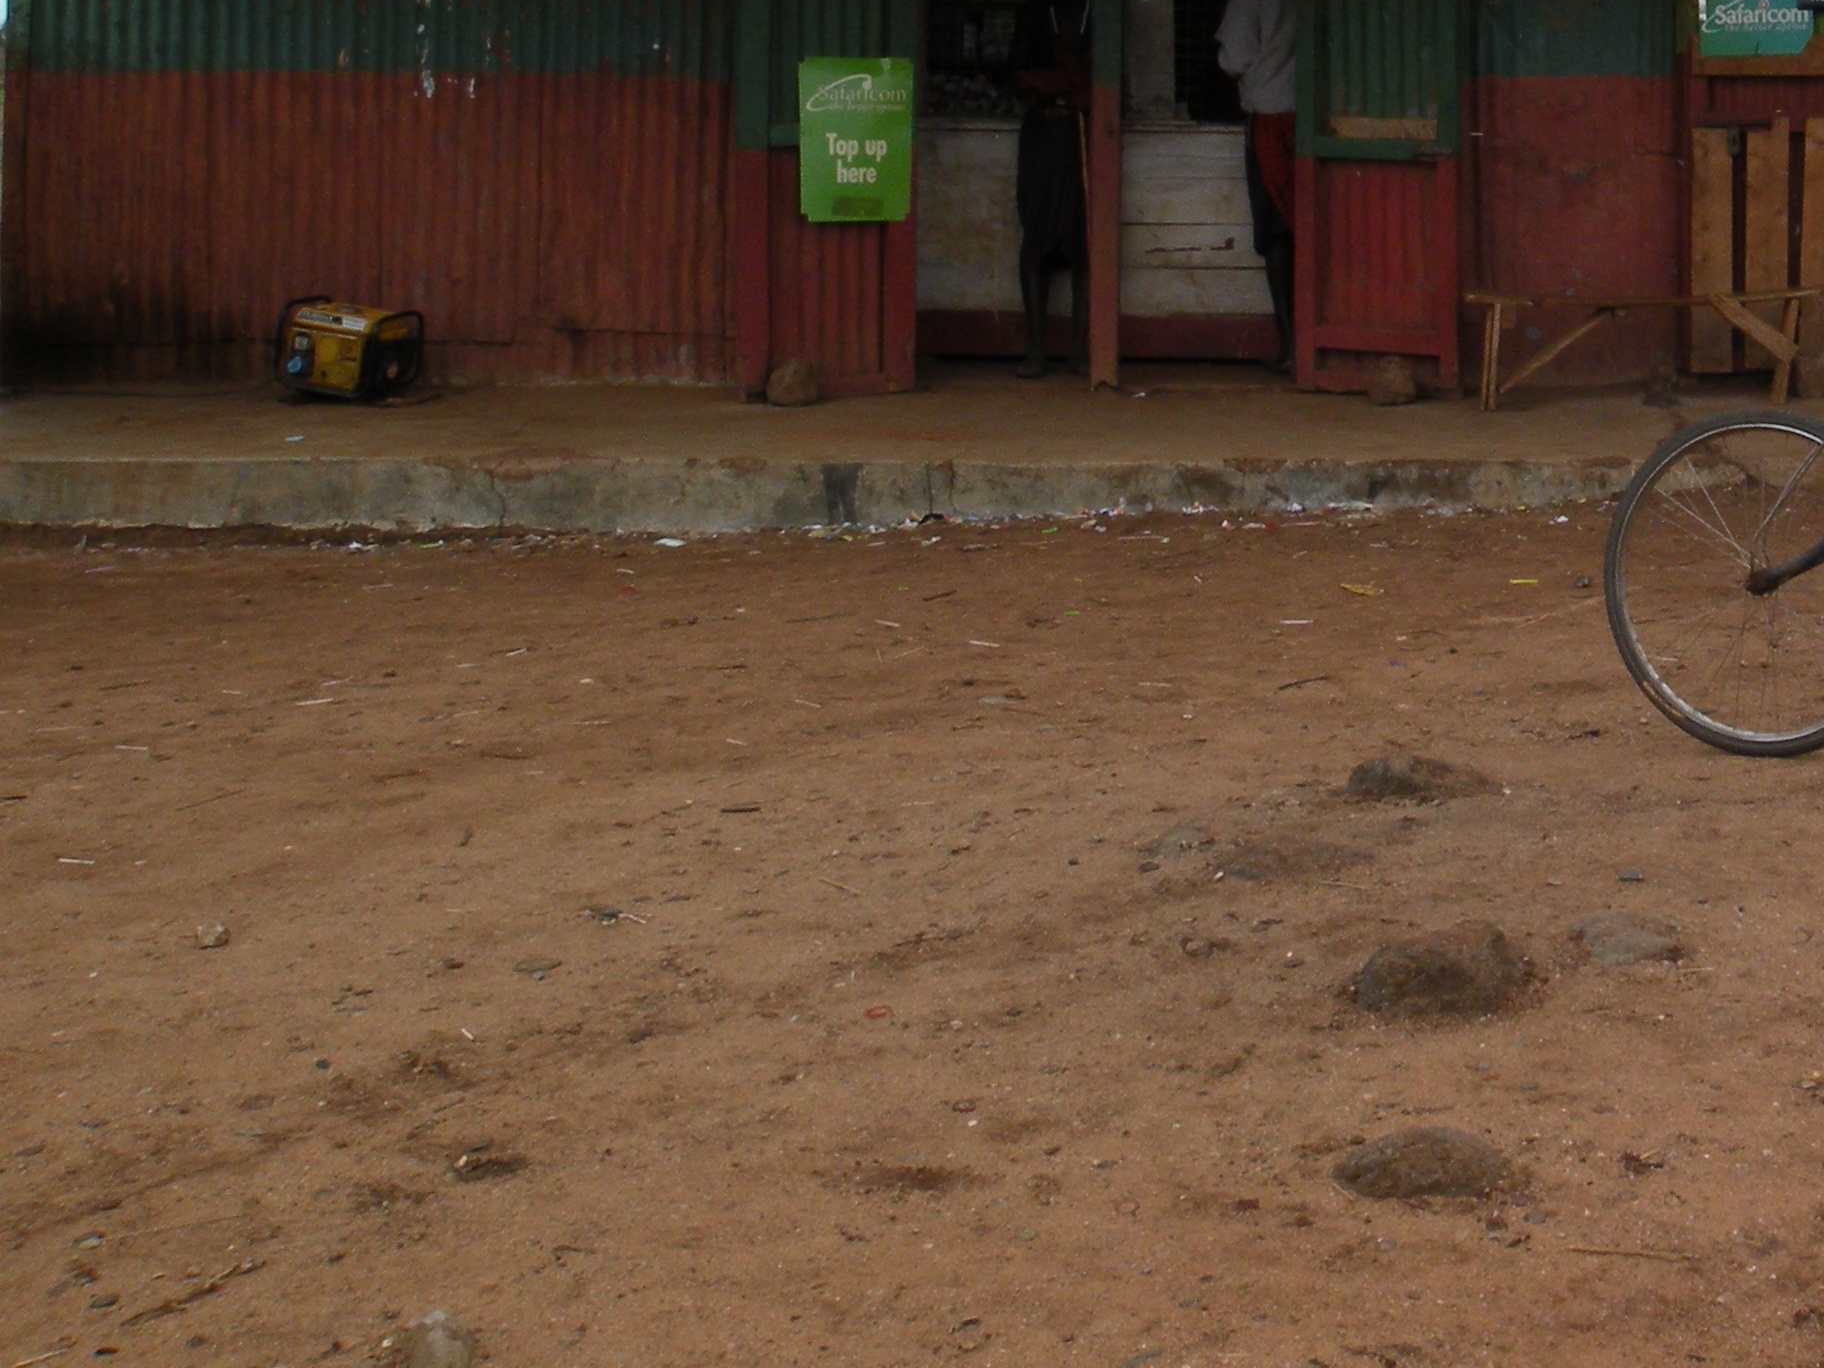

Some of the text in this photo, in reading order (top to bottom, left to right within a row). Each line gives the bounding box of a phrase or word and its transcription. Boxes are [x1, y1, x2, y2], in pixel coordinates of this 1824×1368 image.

[1714, 3, 1809, 25] Safaricom
[817, 85, 906, 103] Safaricom
[825, 133, 888, 163] Top up
[836, 159, 878, 184] here
